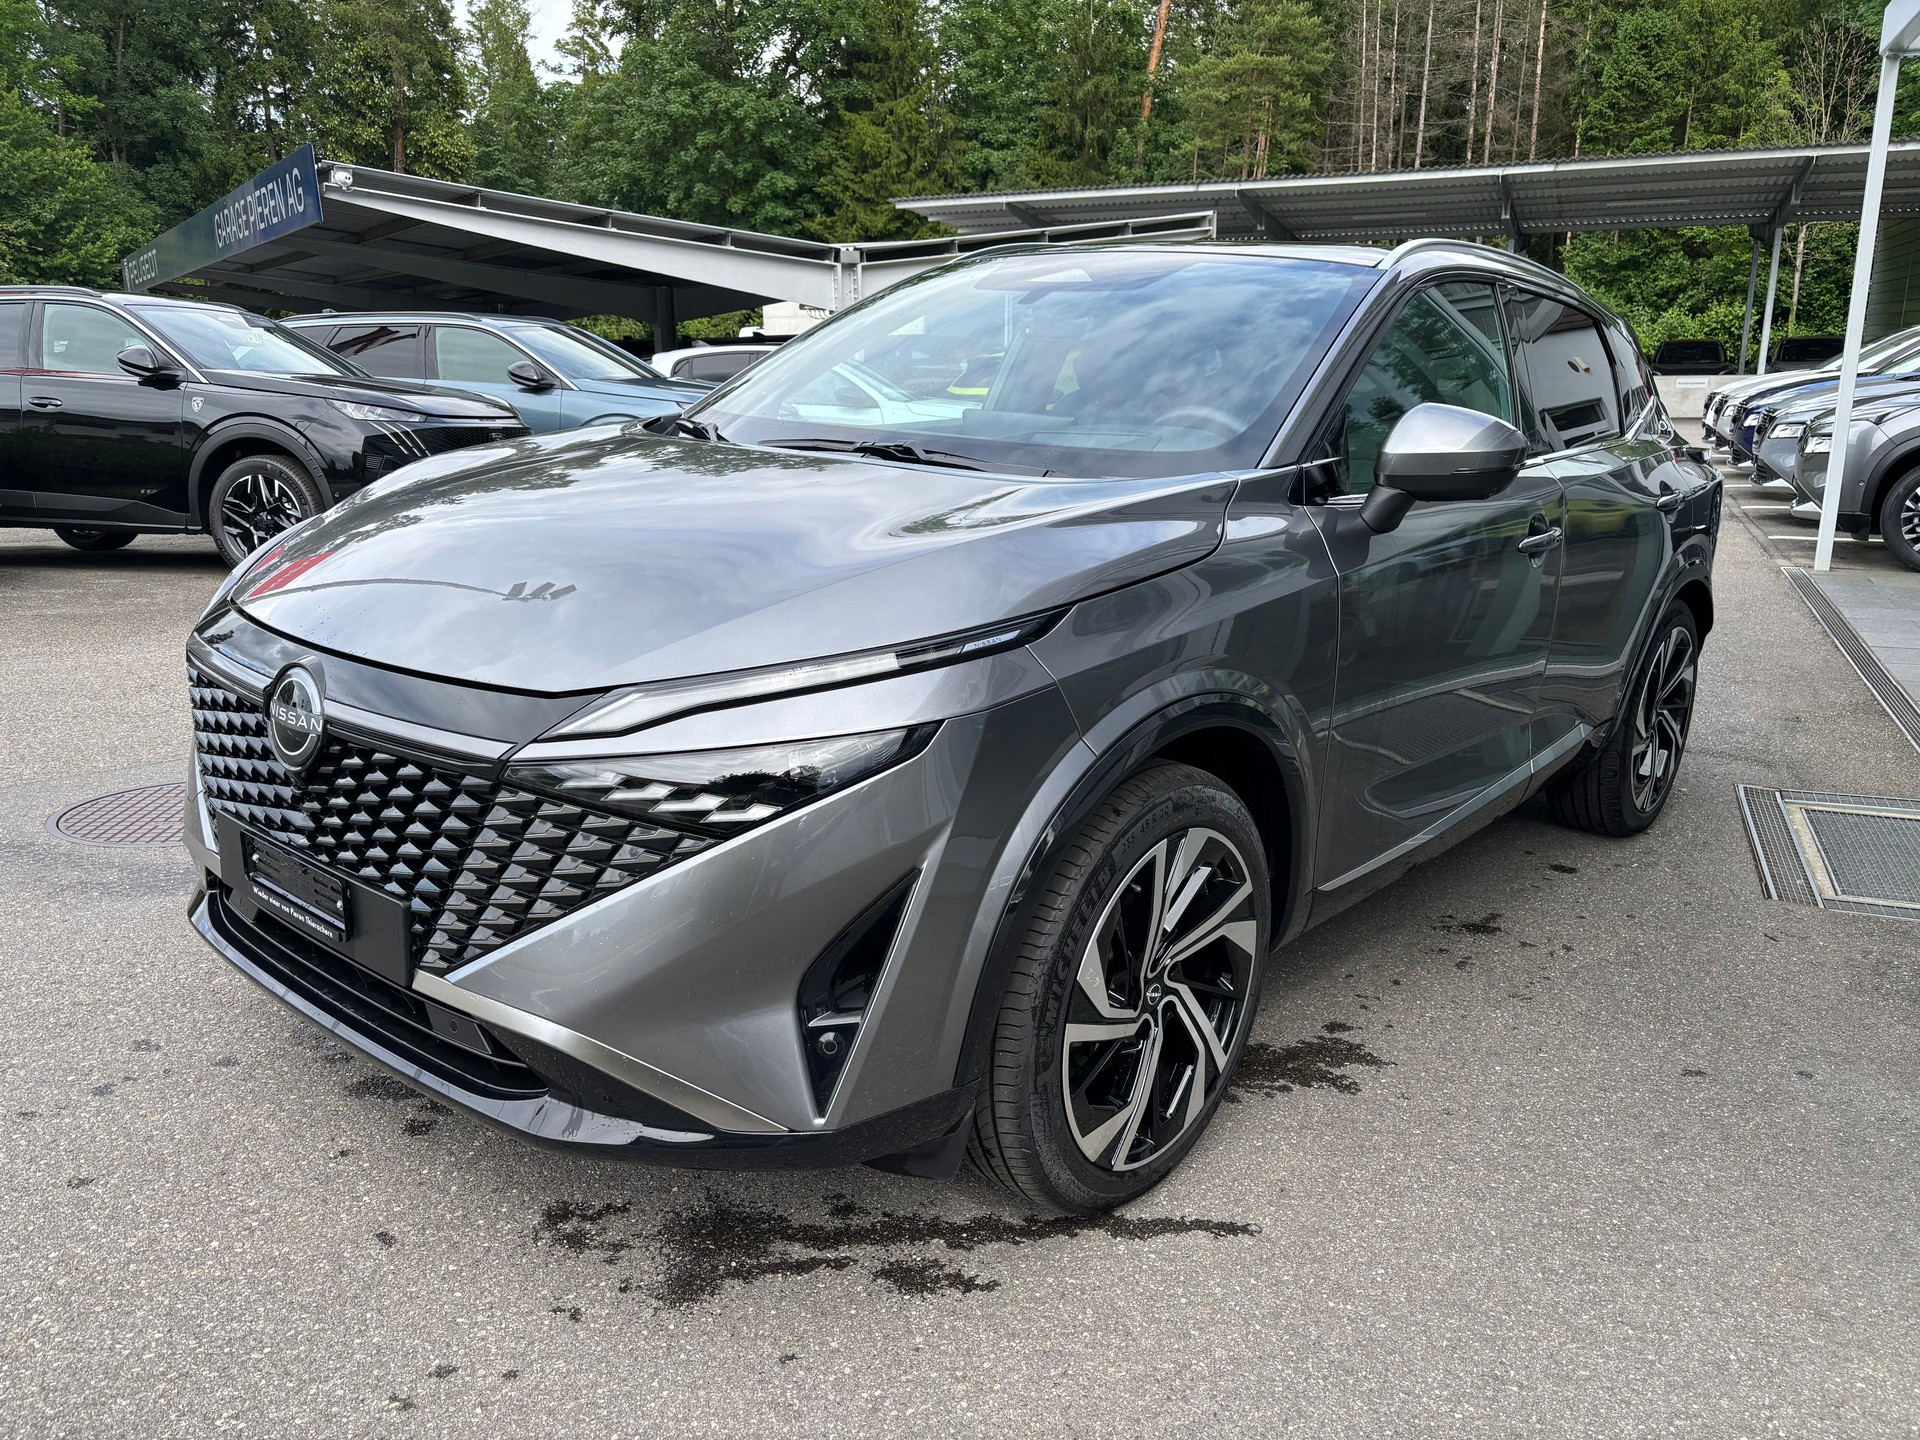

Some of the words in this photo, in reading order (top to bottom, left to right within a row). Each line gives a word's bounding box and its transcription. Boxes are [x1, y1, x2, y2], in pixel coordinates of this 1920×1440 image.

[214, 199, 249, 248] GARAGE
[247, 177, 286, 234] PIEREN
[285, 167, 305, 217] AG
[973, 637, 1002, 648] NISSAN
[269, 700, 323, 733] NISSAN
[1044, 865, 1115, 1026] MICHELIN
